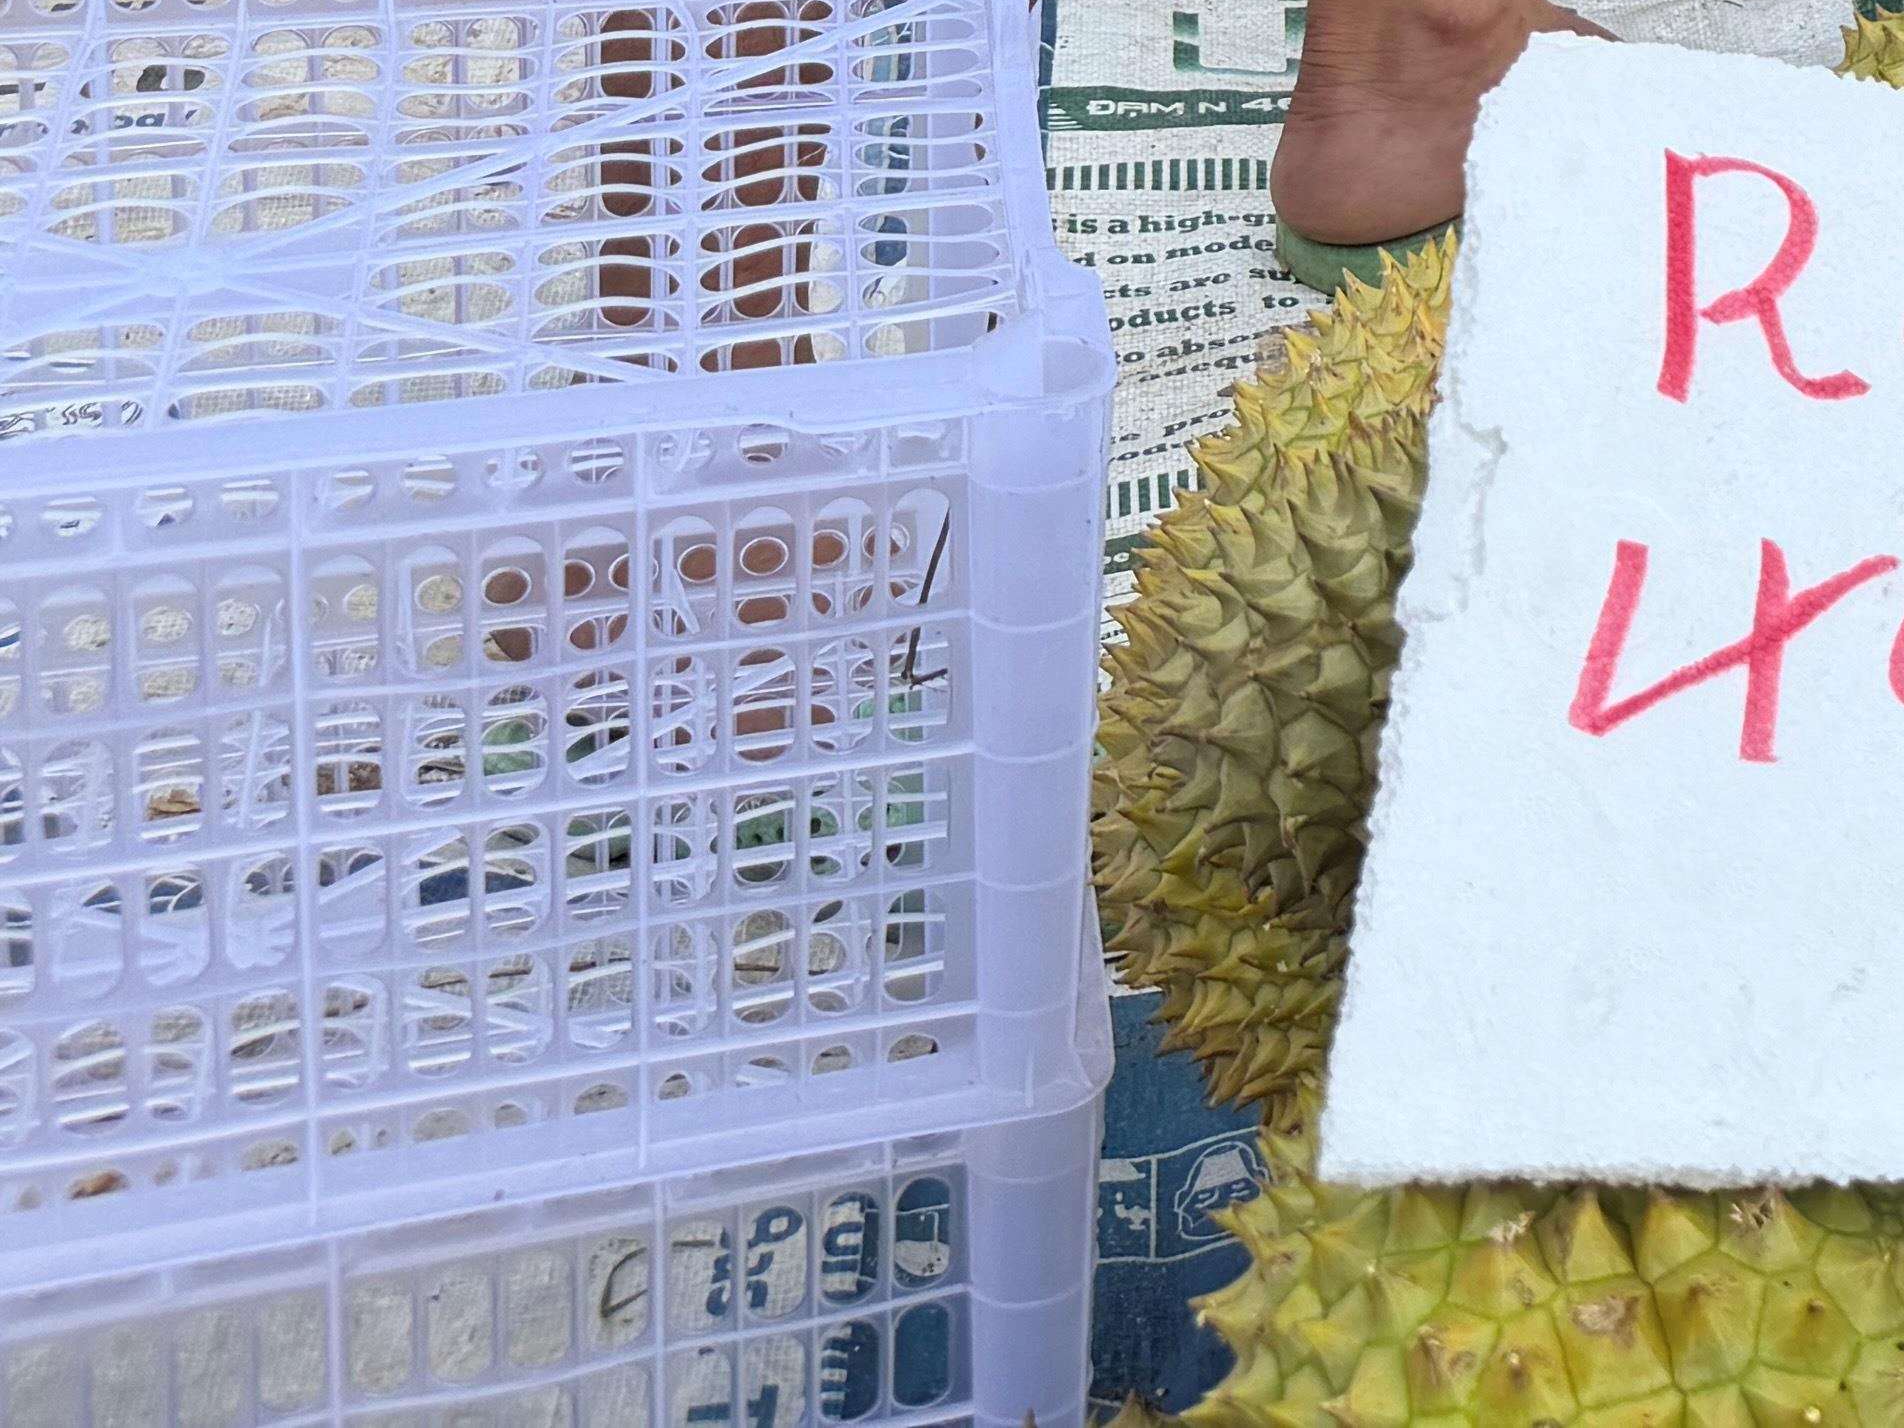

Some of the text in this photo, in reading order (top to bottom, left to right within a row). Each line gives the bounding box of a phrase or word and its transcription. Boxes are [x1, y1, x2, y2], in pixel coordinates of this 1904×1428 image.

[1086, 99, 1186, 119] ĐẠM
[1198, 101, 1228, 115] N
[1067, 213, 1099, 234] is
[1107, 218, 1131, 234] a
[1106, 251, 1157, 265] on
[1169, 271, 1231, 293] are
[1262, 294, 1300, 310] to
